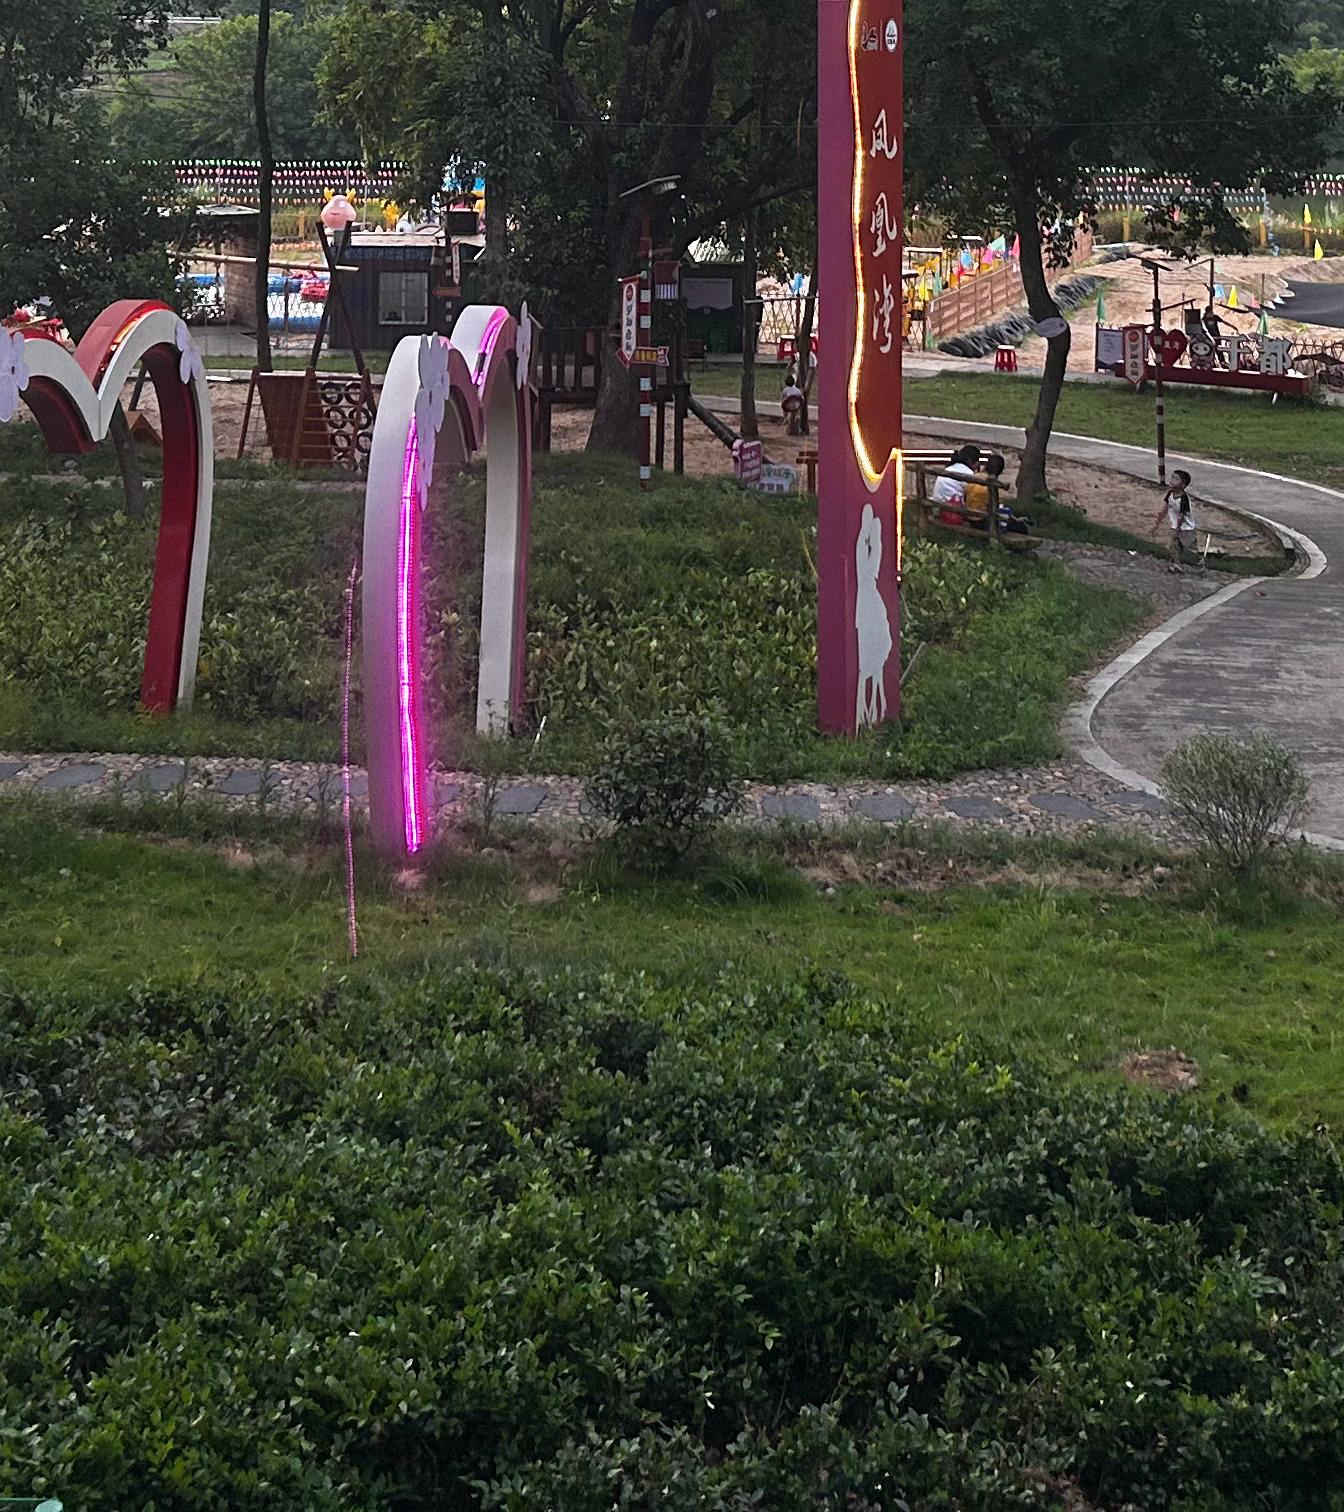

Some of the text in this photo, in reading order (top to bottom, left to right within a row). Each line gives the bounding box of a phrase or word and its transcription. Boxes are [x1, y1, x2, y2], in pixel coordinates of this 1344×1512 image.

[869, 108, 898, 354] 凤凰湾
[1213, 334, 1294, 375] 于都
